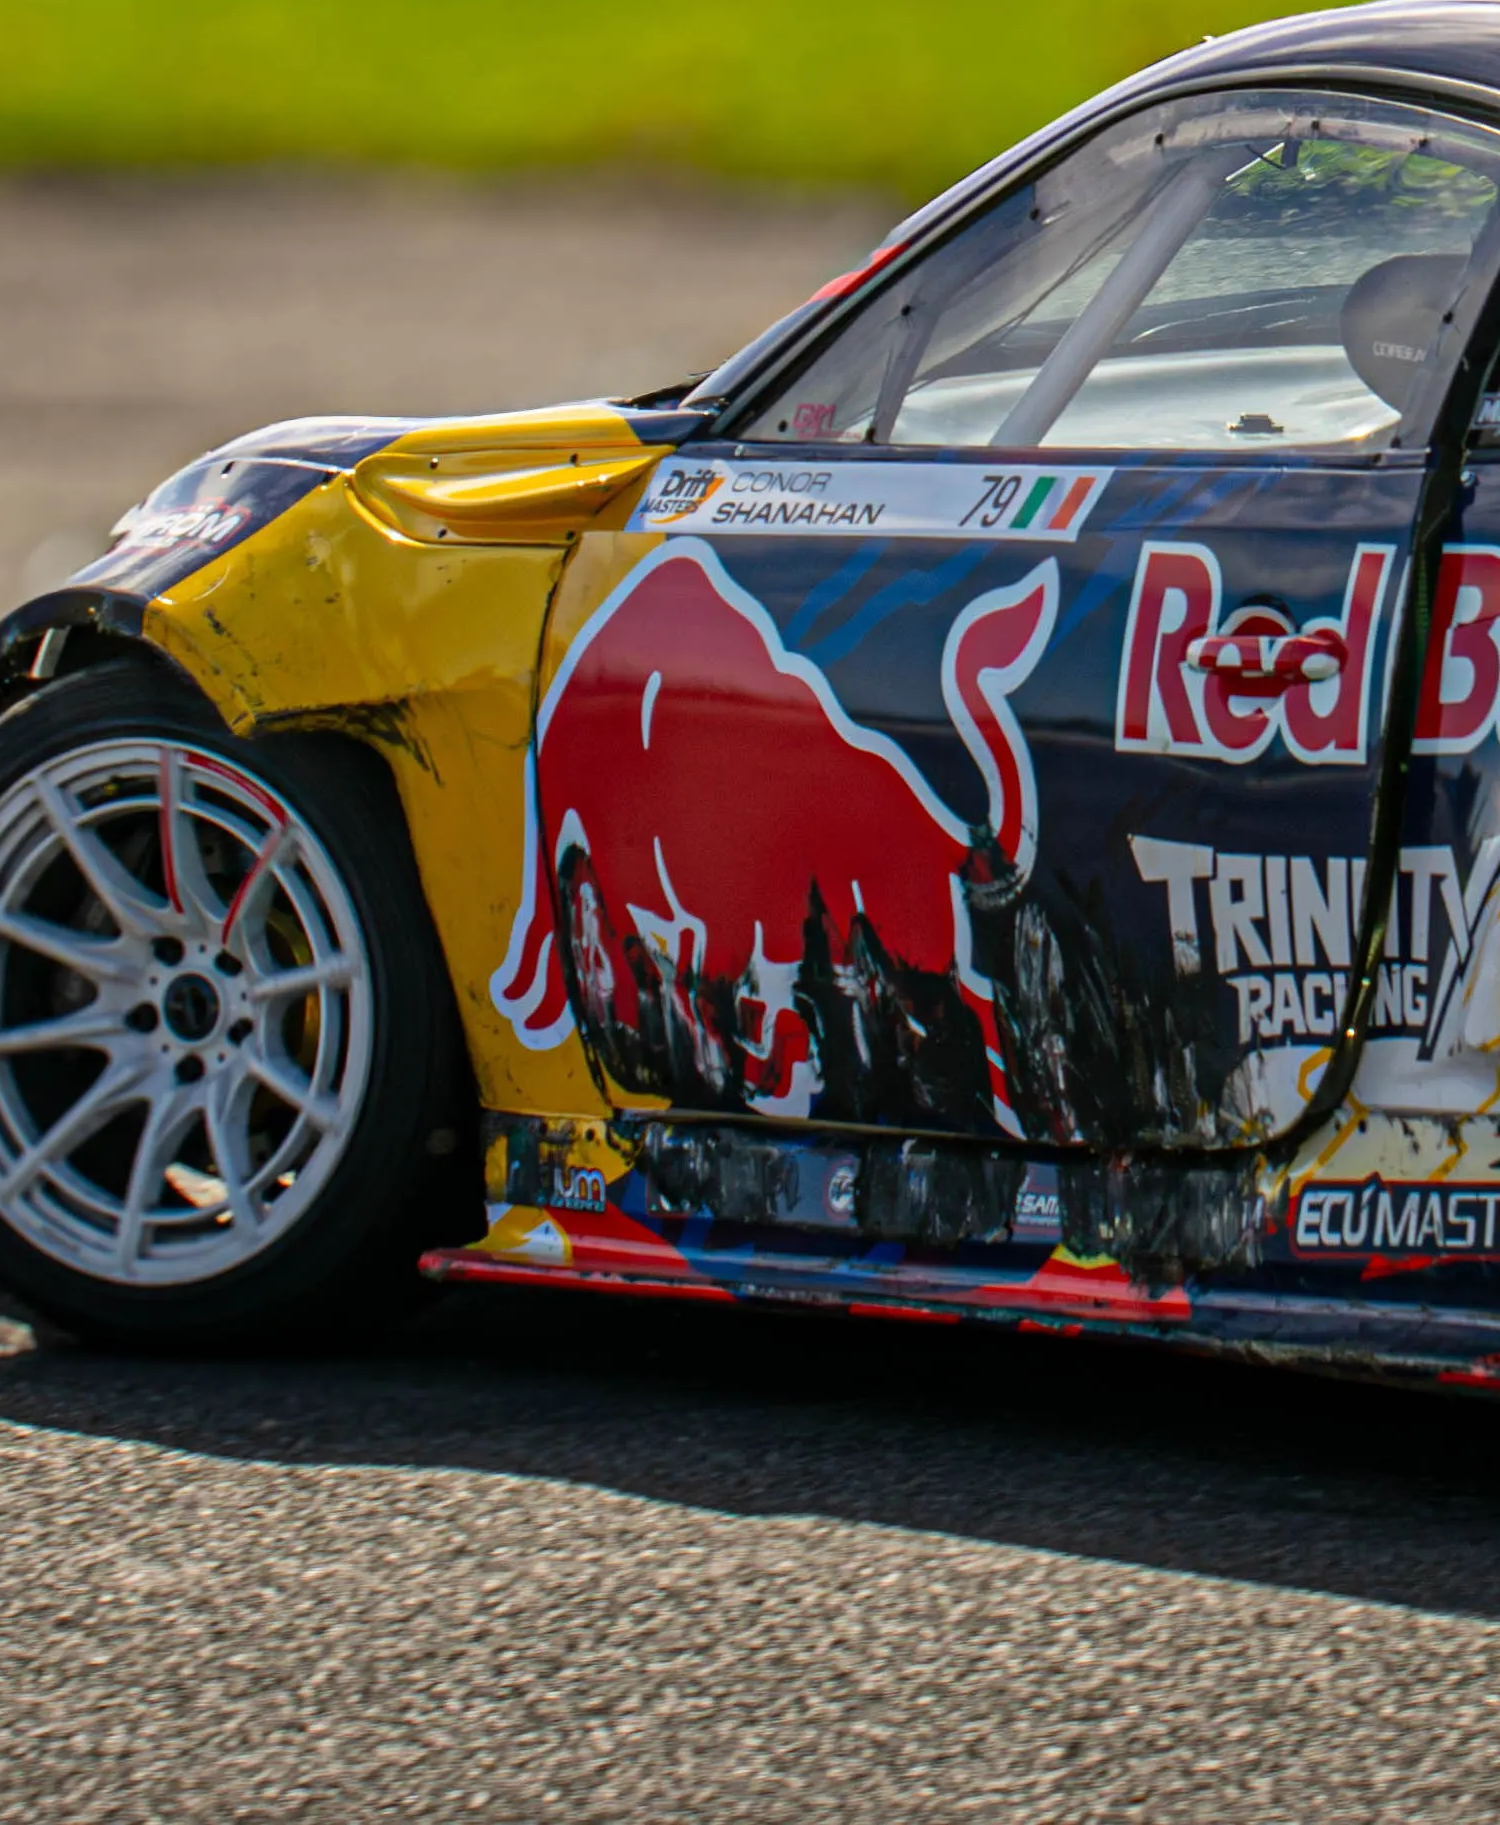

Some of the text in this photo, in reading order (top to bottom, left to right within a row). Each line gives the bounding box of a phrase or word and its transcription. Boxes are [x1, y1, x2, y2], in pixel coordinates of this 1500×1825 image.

[659, 468, 717, 497] Drift
[731, 472, 832, 493] CONOR
[959, 475, 1022, 527] 79
[712, 501, 886, 525] SHANAHAN
[1115, 541, 1397, 765] Red
[1227, 963, 1428, 1045] RACING
